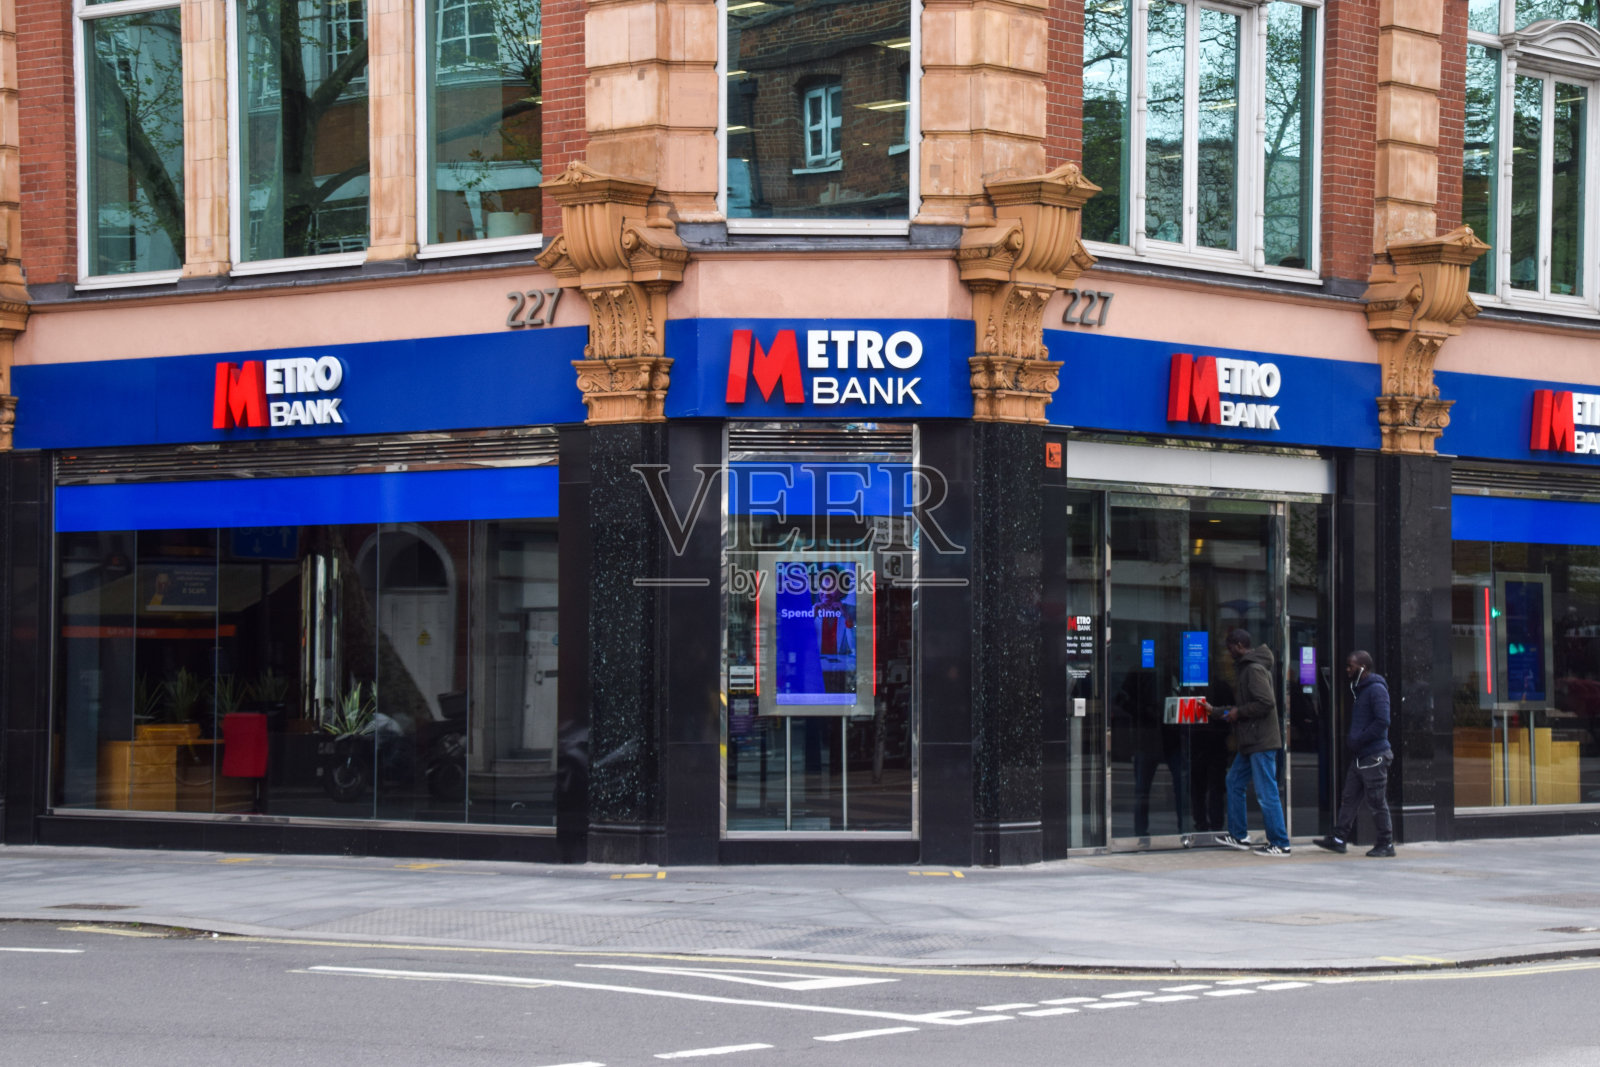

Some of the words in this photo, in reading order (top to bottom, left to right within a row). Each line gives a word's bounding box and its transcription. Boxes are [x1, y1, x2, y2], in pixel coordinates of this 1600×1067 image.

[506, 288, 562, 328] 227
[1063, 288, 1115, 326] 227
[726, 329, 923, 405] METRO
[213, 356, 344, 430] METRO
[812, 376, 922, 405] BANK
[1167, 353, 1282, 425] METRO
[270, 398, 343, 427] BANK
[1220, 403, 1281, 430] BANK
[1530, 389, 1600, 453] MET
[1574, 431, 1600, 454] BA
[781, 609, 815, 619] Spend
[818, 608, 842, 618] time
